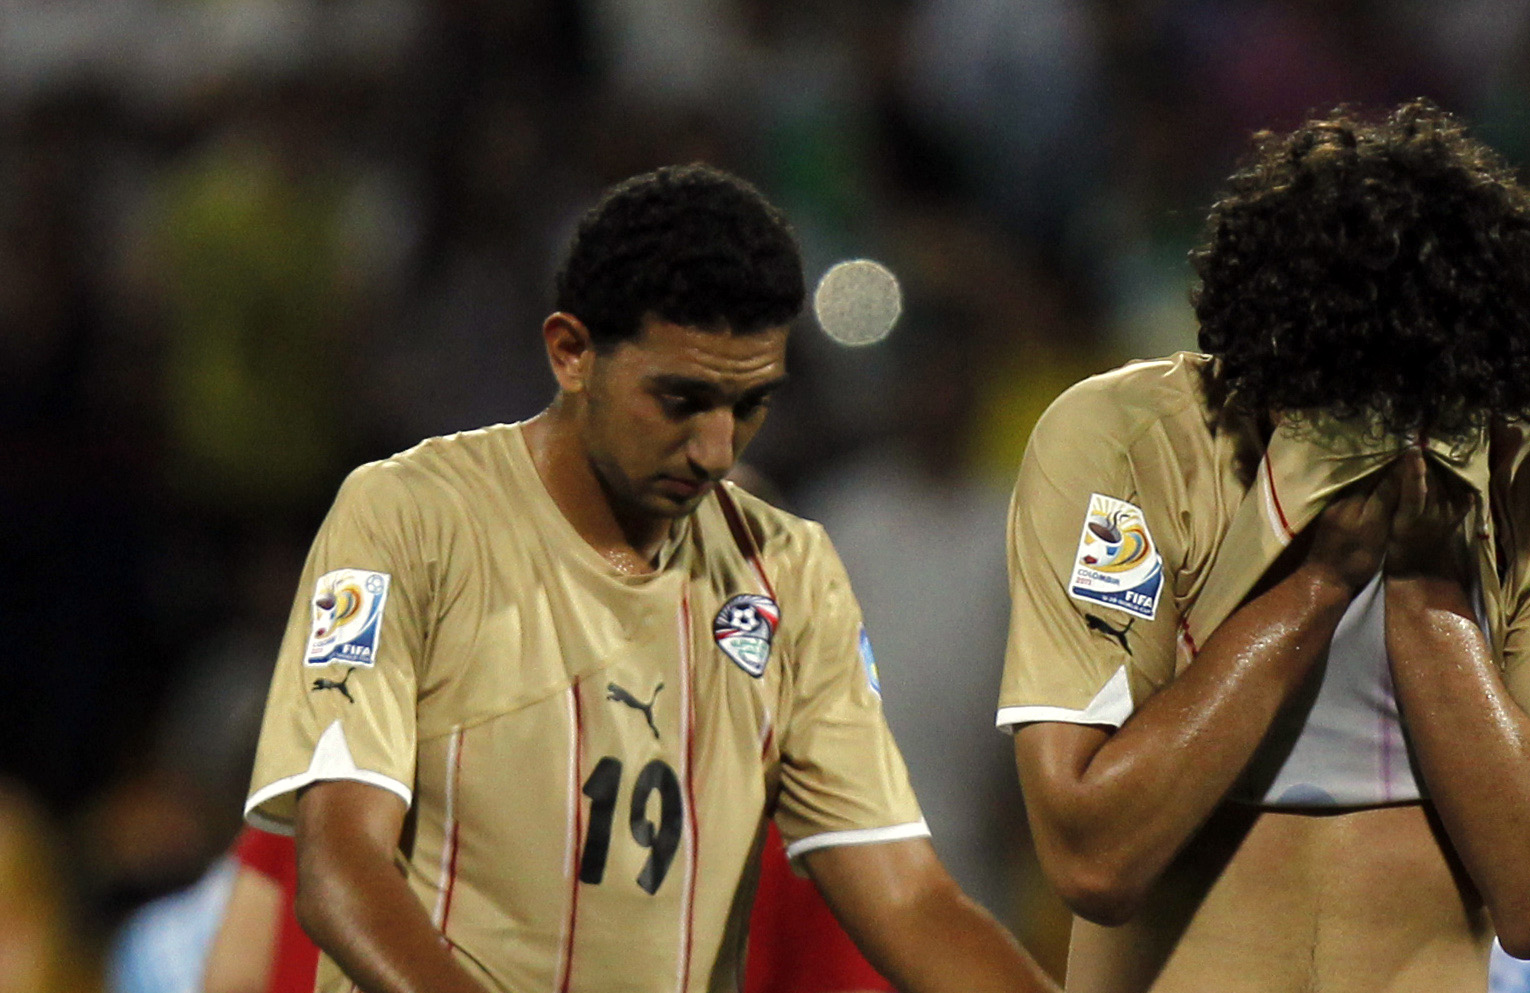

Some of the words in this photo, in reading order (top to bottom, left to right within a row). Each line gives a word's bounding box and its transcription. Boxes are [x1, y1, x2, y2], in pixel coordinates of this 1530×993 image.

[1124, 590, 1153, 608] FIFA
[342, 643, 371, 656] FIFA
[579, 755, 683, 896] 19
